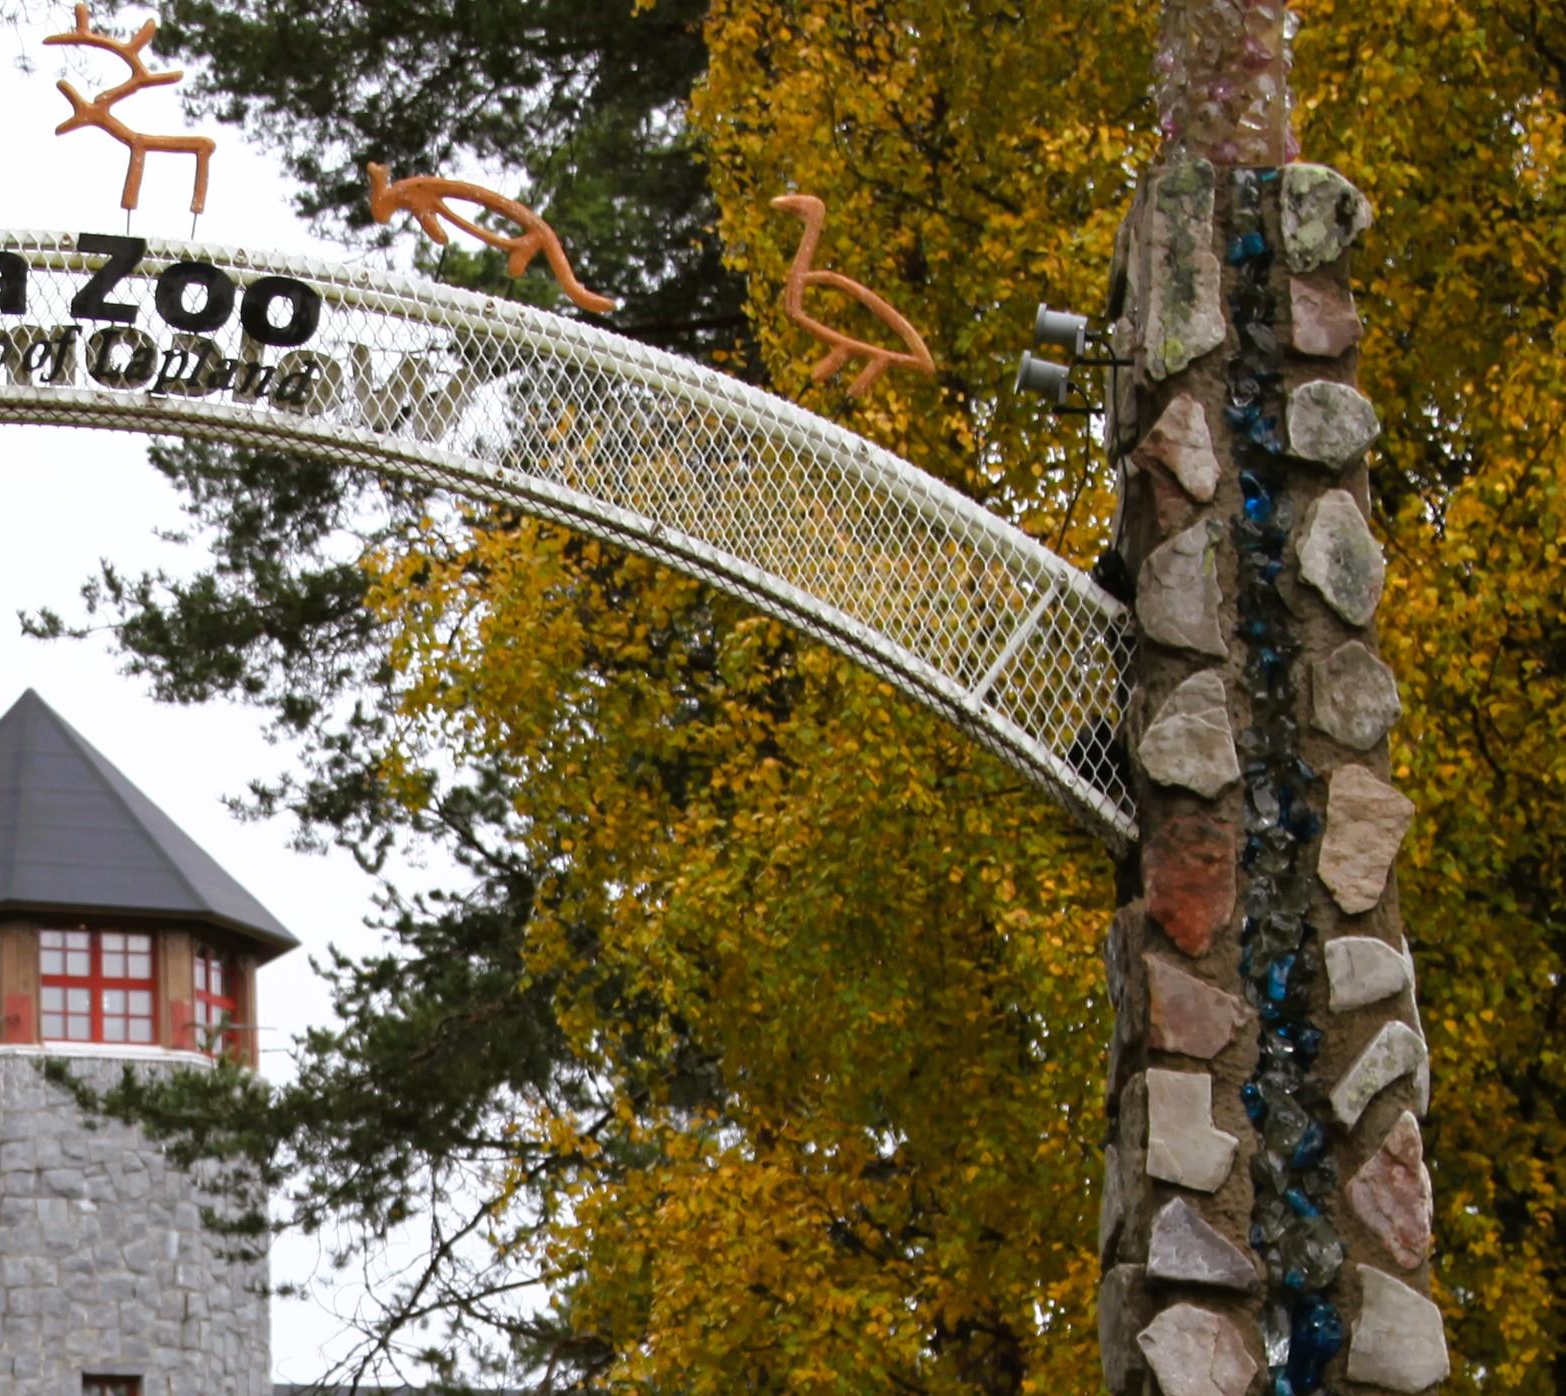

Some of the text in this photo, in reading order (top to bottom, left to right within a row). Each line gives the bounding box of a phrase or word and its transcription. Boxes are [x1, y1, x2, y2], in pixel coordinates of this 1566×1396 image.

[70, 233, 323, 347] Zoo
[22, 326, 82, 383] of
[92, 328, 322, 404] Lapland
